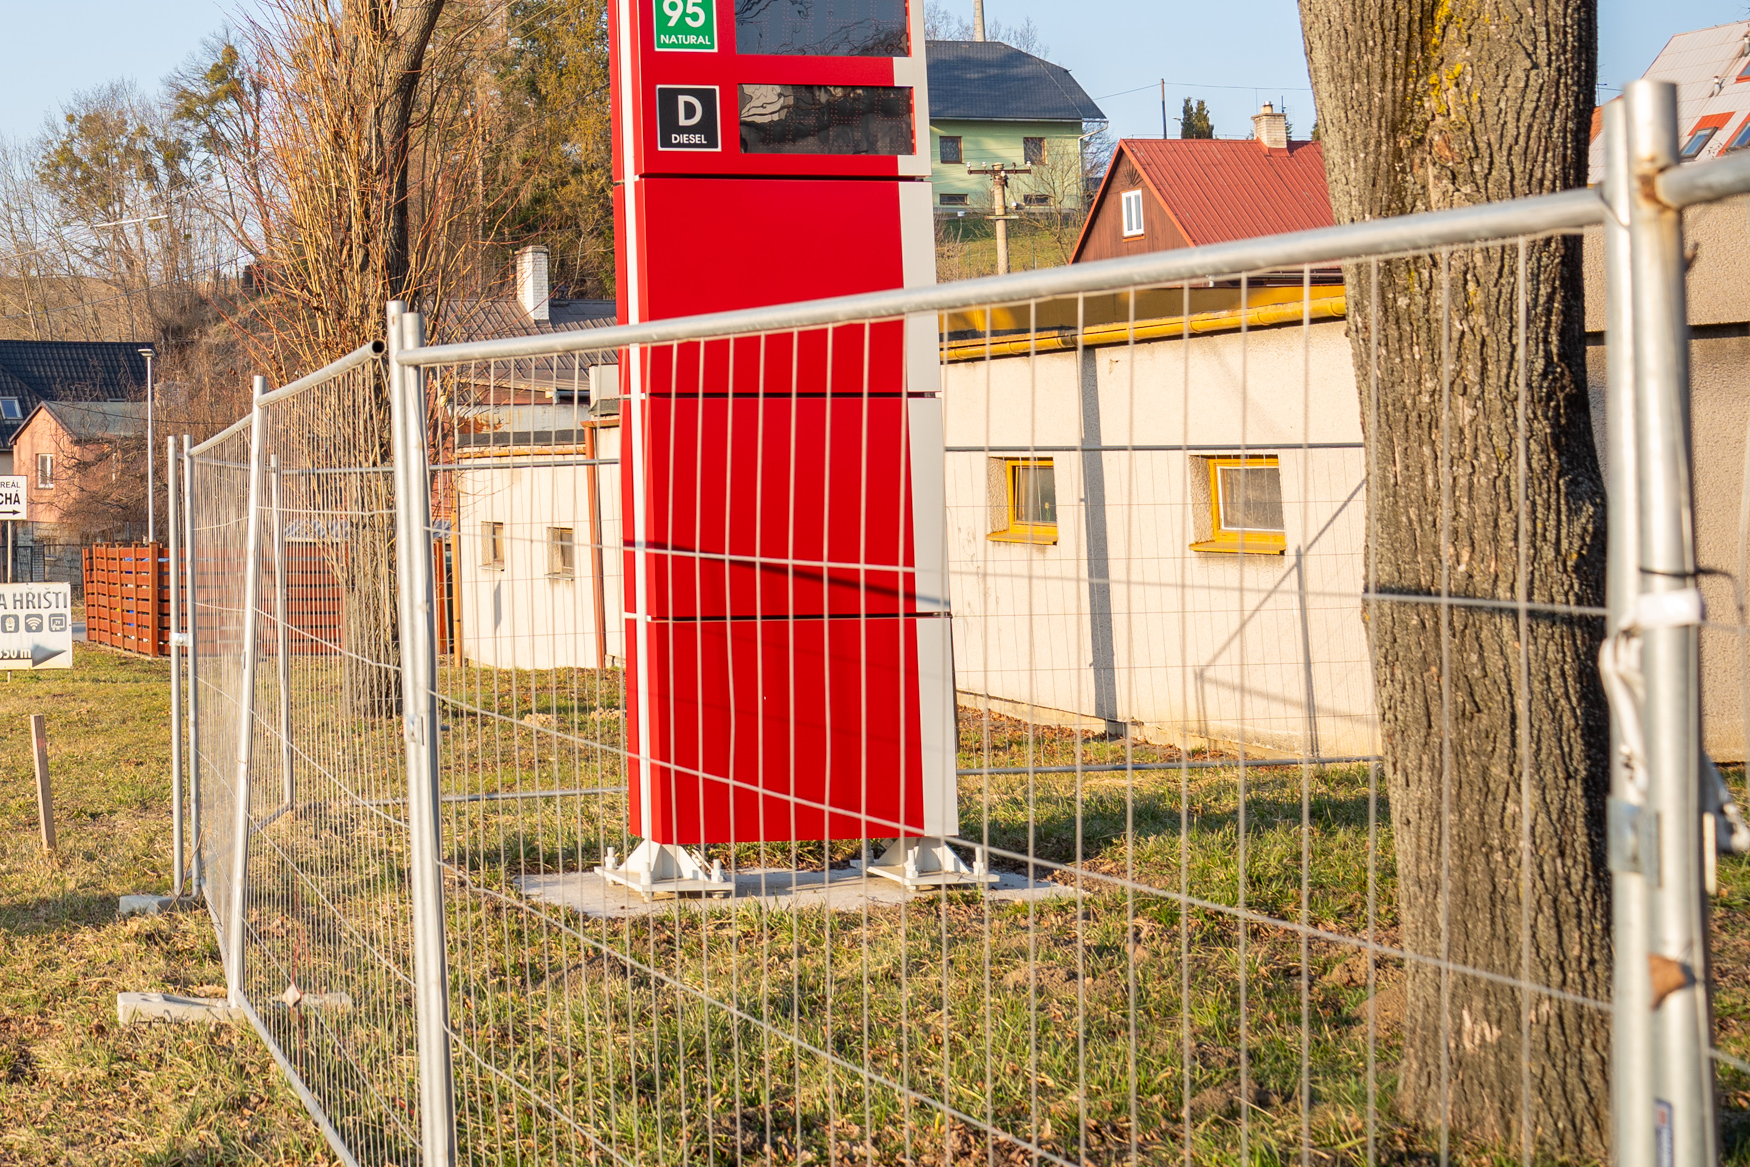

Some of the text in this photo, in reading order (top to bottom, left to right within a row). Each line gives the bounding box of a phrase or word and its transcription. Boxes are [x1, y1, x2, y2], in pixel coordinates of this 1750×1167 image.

[659, 33, 712, 46] NATURAL
[677, 94, 703, 127] D
[671, 132, 708, 145] DIESEL
